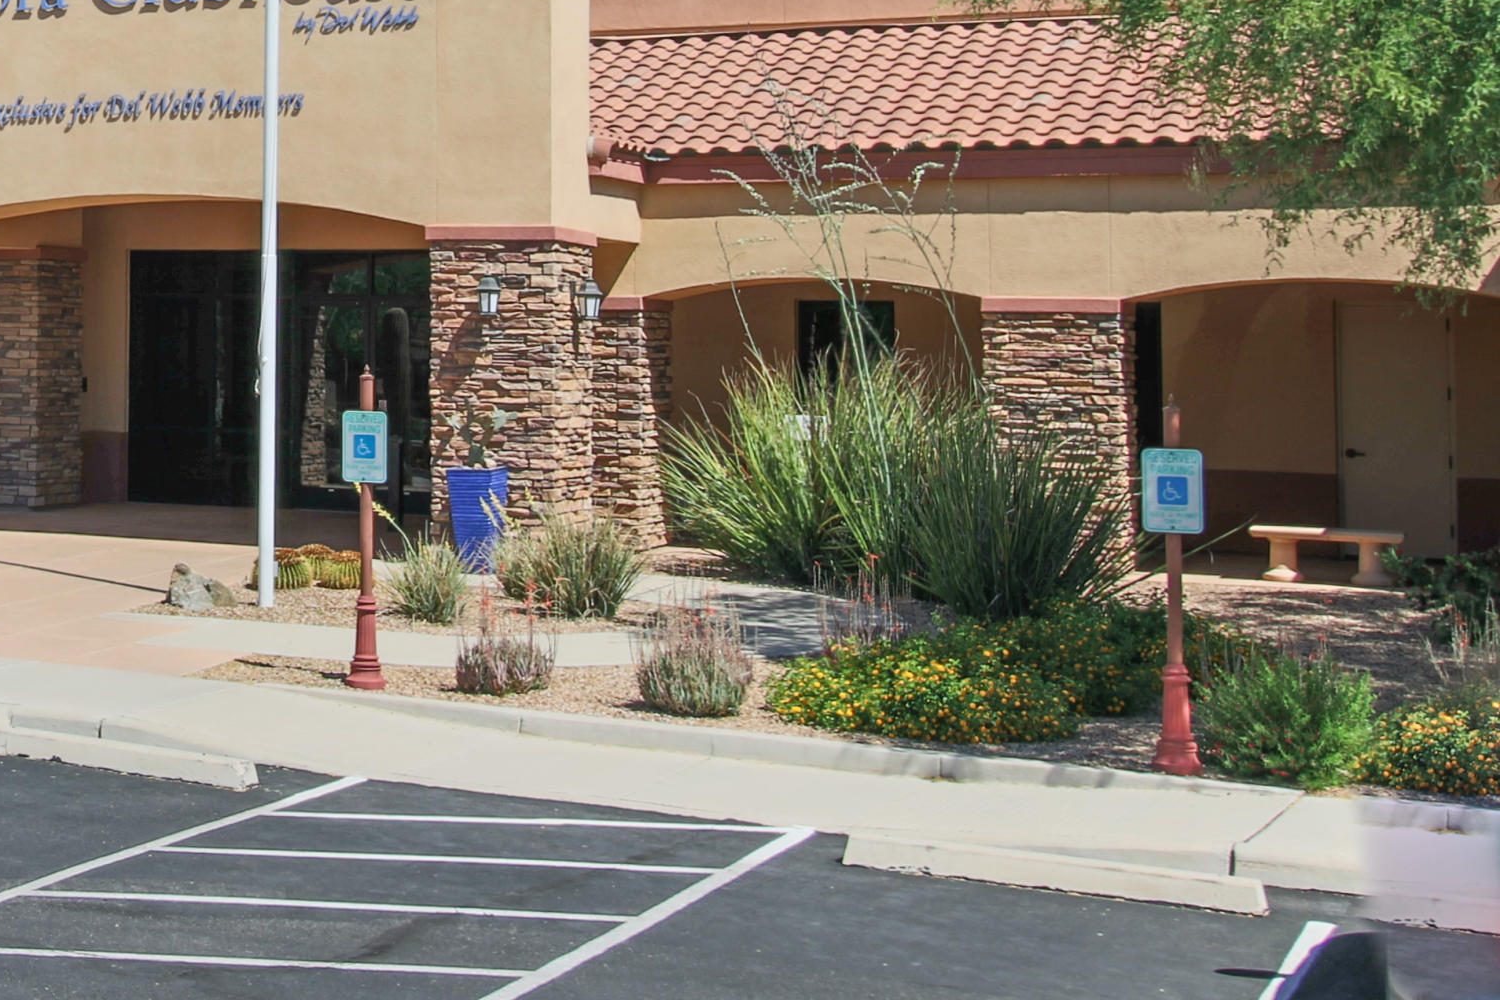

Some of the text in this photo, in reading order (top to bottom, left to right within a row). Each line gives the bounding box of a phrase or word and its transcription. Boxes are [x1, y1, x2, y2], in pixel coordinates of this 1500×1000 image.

[293, 5, 419, 45] by Del Webb
[63, 92, 102, 134] for
[103, 90, 146, 123] Del
[146, 88, 206, 121] Webb
[208, 90, 305, 121] Memers
